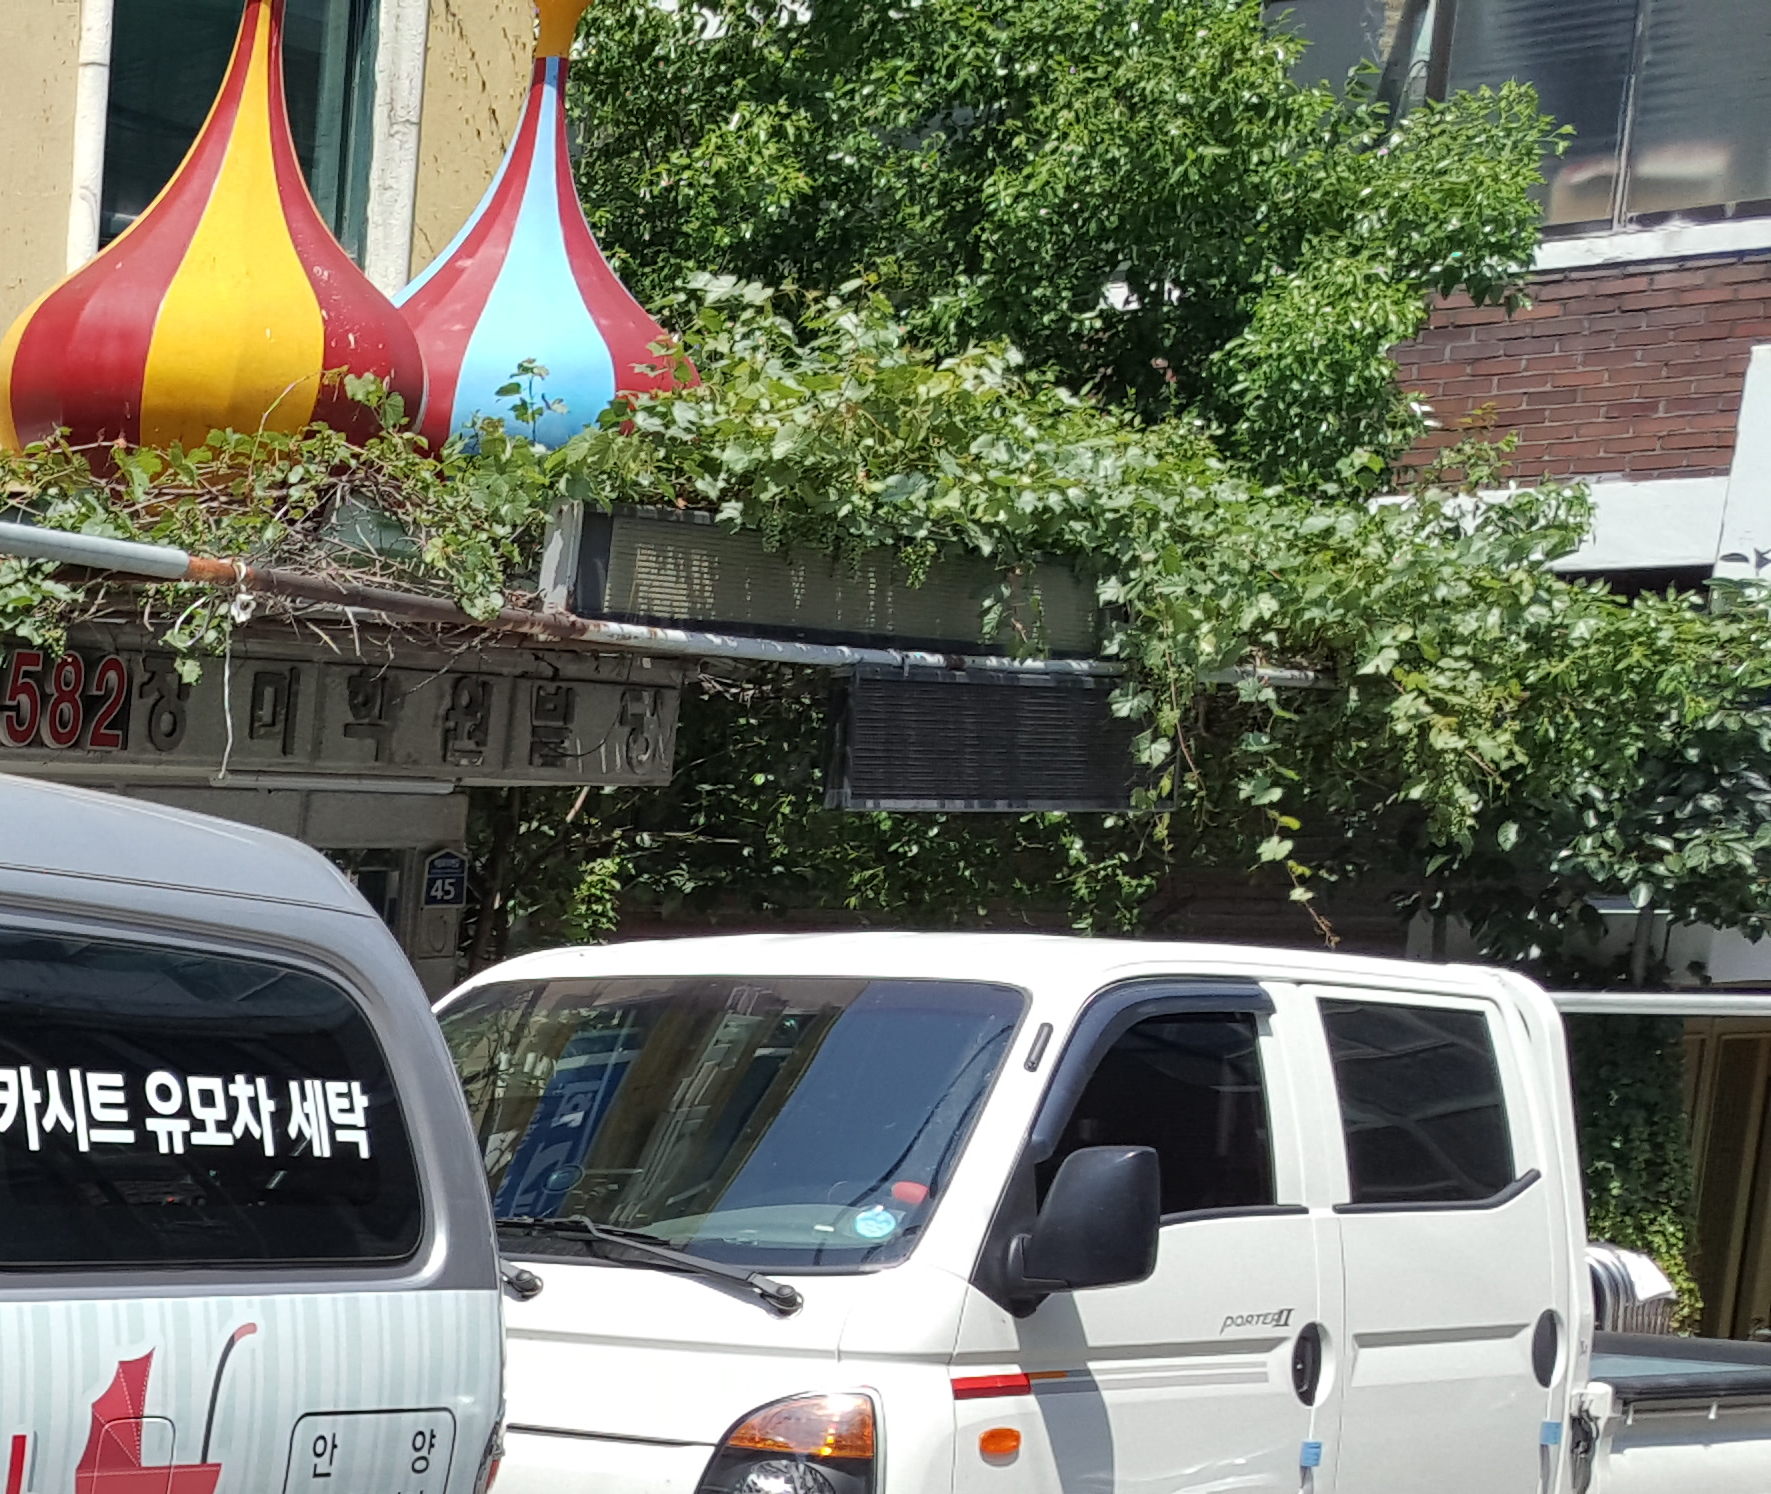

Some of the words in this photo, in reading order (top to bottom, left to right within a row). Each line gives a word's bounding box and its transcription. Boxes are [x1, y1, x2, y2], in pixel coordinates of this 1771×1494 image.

[430, 878, 456, 900] 45
[144, 1070, 275, 1158] 유모차
[287, 1079, 371, 1160] 세탁
